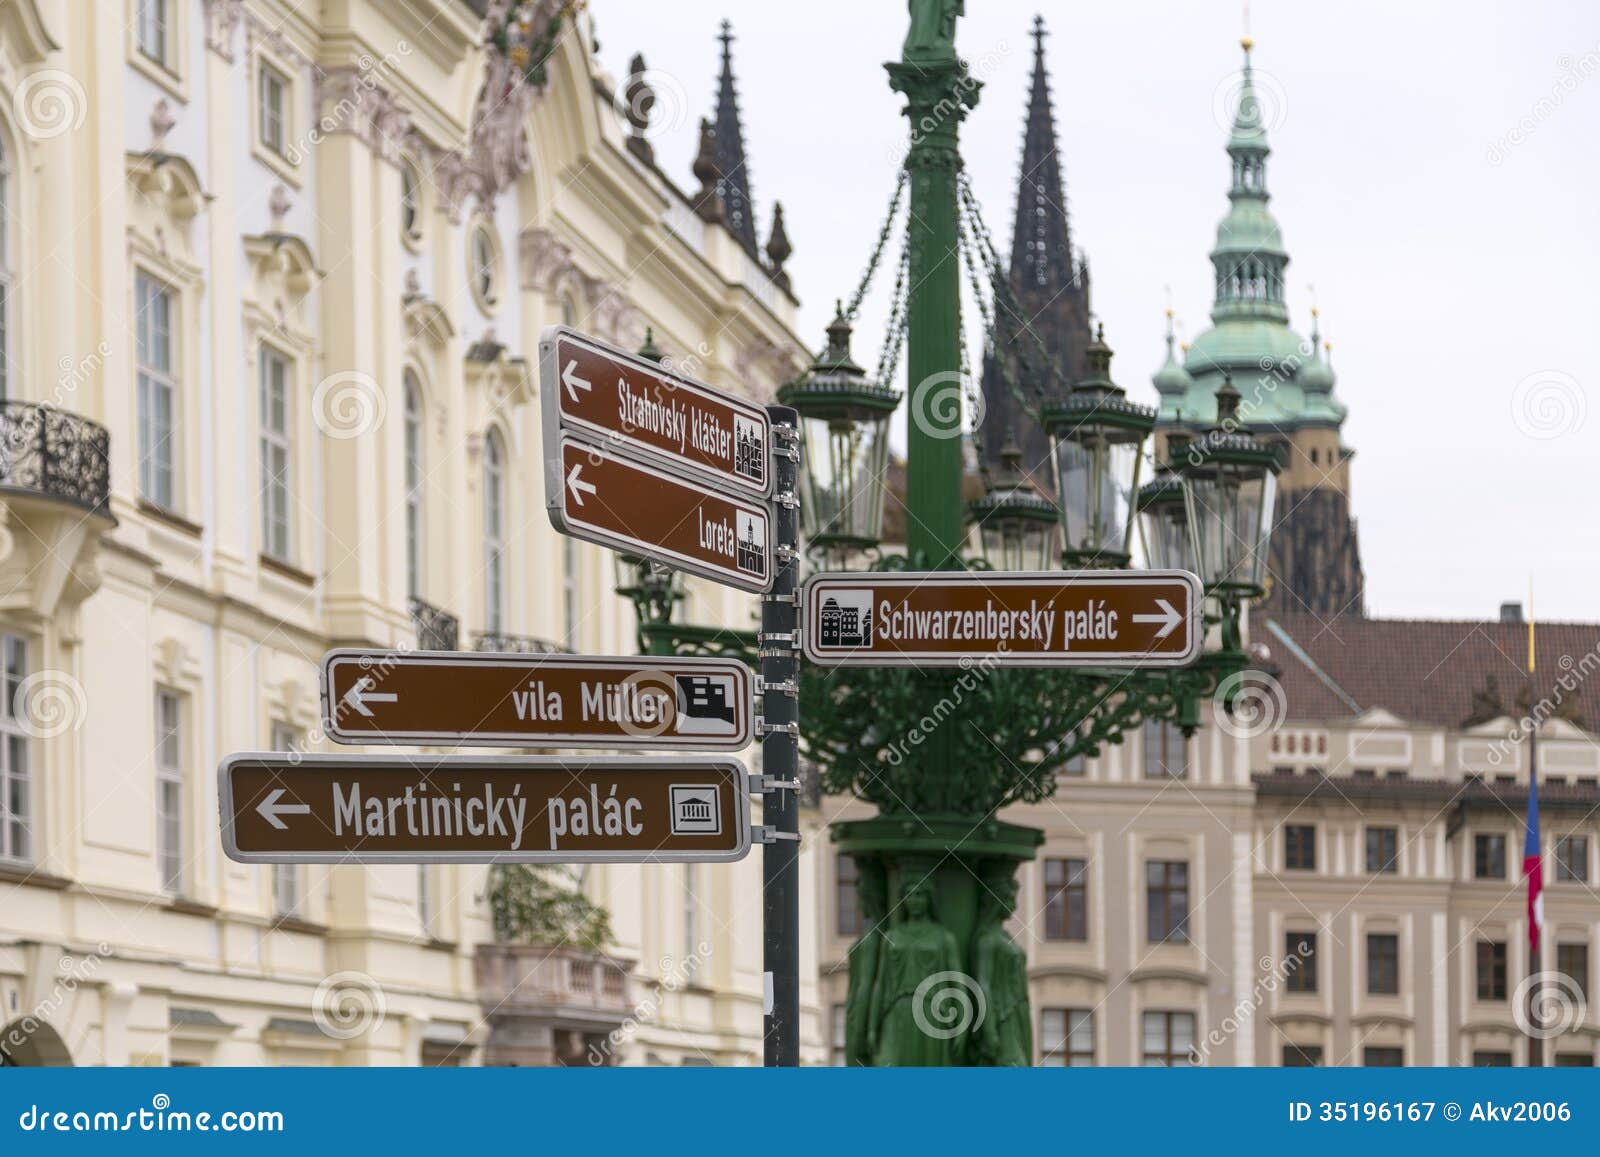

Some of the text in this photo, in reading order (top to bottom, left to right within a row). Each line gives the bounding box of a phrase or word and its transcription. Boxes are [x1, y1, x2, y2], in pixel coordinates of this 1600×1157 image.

[617, 377, 732, 461] Strahovský klášter
[699, 506, 735, 558] Loreta
[879, 599, 1118, 650] Schwarzenberský palác
[512, 680, 669, 724] vila Müller
[332, 781, 643, 851] Martinický palác
